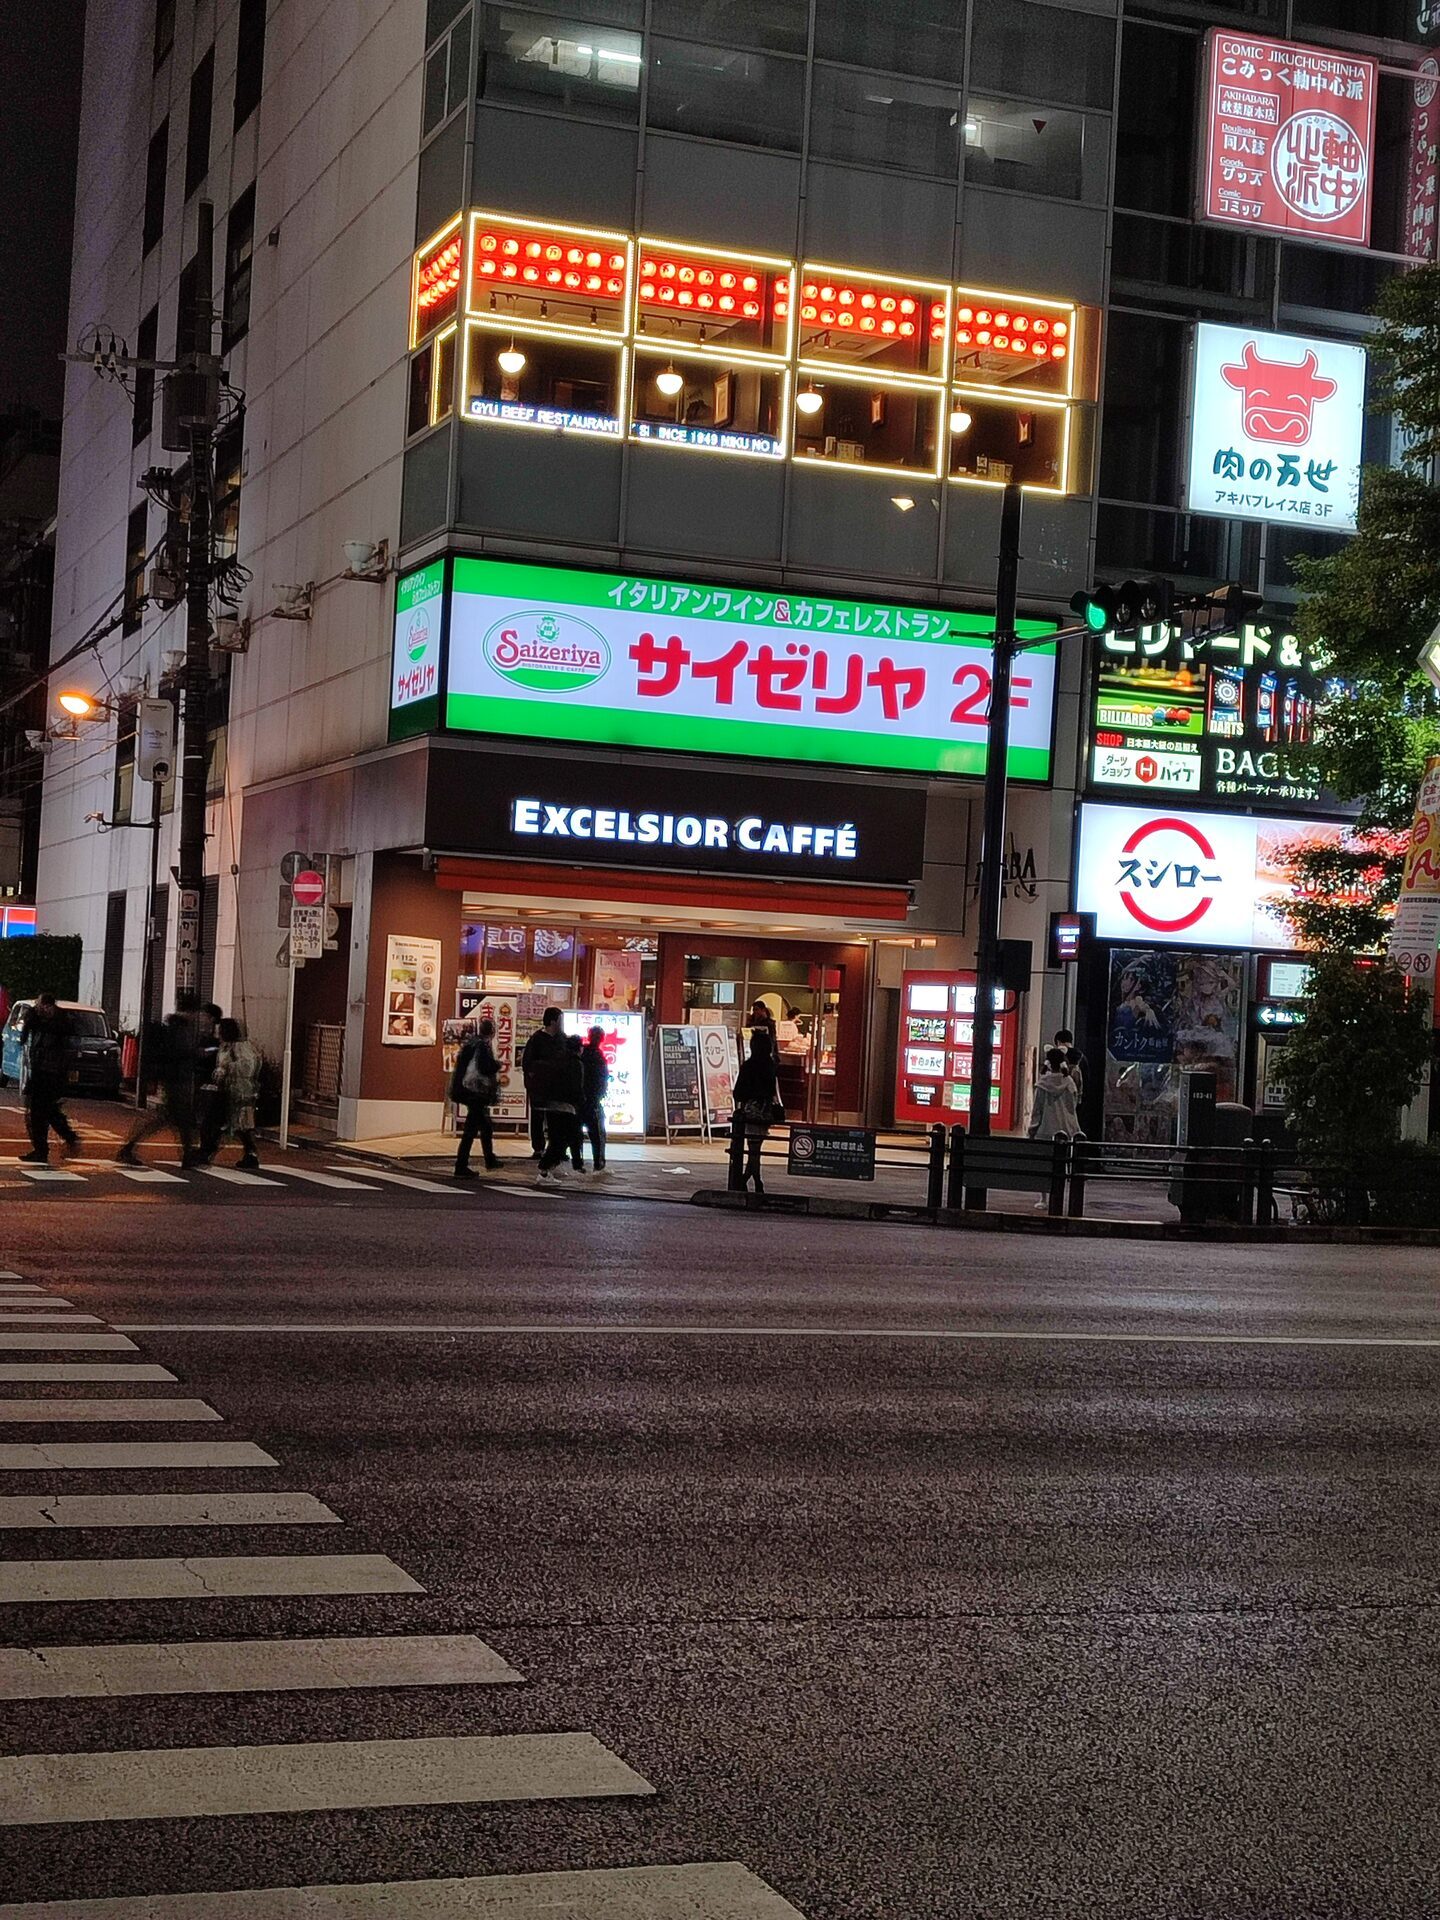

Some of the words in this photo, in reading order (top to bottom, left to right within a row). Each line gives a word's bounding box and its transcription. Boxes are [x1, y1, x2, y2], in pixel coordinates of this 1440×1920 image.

[1222, 42, 1263, 60] COMIC
[1268, 51, 1366, 79] JIKUCHUSHINHA
[1222, 57, 1364, 100] こみっく軸中心派
[1223, 90, 1275, 107] AKIHABARA
[1221, 100, 1276, 122] 秋葉原本店
[1222, 123, 1256, 135] Doujinshi
[1224, 135, 1266, 156] 同人誌
[1220, 156, 1244, 167] Goods
[1222, 166, 1263, 187] グッズ
[1218, 188, 1242, 199] Comic
[1219, 199, 1263, 218] コミック
[471, 400, 499, 416] GYU
[501, 405, 535, 421] BEEF
[537, 410, 621, 433] RESTAURANT
[721, 434, 750, 449] NIKU
[752, 438, 770, 452] NO
[1212, 446, 1338, 493] 肉の万世
[1215, 490, 1311, 516] アキバプレイス店
[1315, 503, 1334, 518] 3F
[496, 630, 601, 667] Saizeriya
[398, 664, 435, 702] サイゼリヤ
[628, 632, 927, 721] サイゼリヤ
[1099, 709, 1154, 728] BILLIARDS
[1209, 720, 1245, 736] DARTS
[1096, 732, 1123, 747] SHOP
[1106, 754, 1128, 766] ダーツ
[1101, 766, 1132, 778] ショップ
[1216, 780, 1320, 801] 各種パーティー承ります。
[514, 799, 728, 849] EXCELSIOR
[738, 817, 858, 859] CAFFÉ
[1115, 857, 1223, 889] スシロー
[704, 1046, 725, 1056] スシロー
